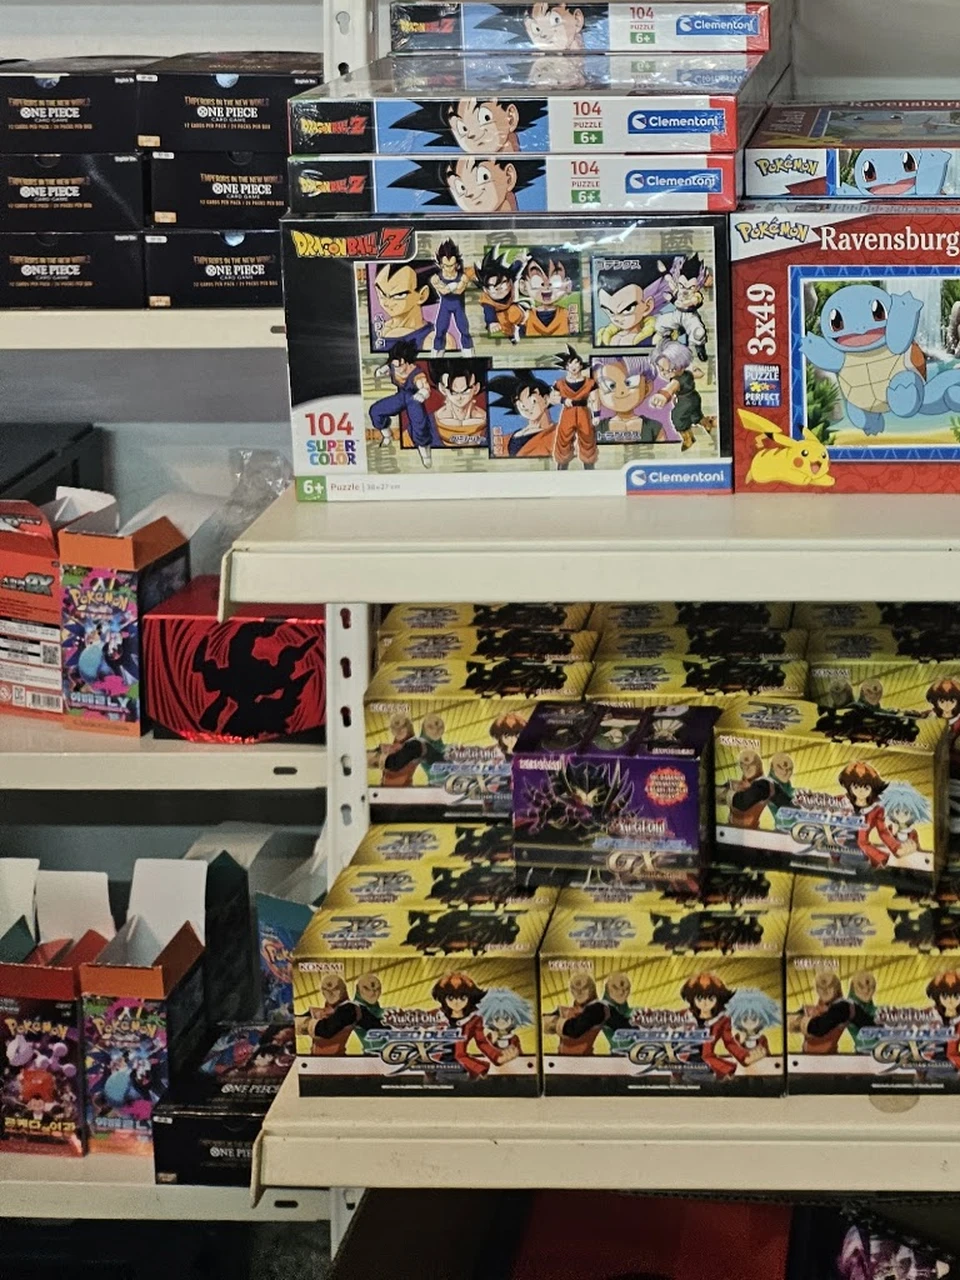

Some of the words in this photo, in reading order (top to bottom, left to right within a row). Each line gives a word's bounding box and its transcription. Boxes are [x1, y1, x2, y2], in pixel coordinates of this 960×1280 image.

[629, 6, 654, 19] 104
[694, 19, 755, 32] Clementoni
[635, 33, 651, 43] 6+
[20, 107, 47, 118] ONE
[48, 107, 80, 118] PIECE
[197, 106, 225, 117] ONE
[226, 106, 258, 117] PIECE
[573, 101, 602, 116] 104
[649, 114, 719, 128] Clementoni
[580, 132, 598, 143] 6+
[570, 160, 600, 176] 104
[646, 174, 717, 190] Clementoni
[20, 186, 47, 198] ONE
[48, 186, 80, 197] PIECE
[212, 183, 239, 195] ONE
[240, 183, 272, 195] PIECE
[578, 191, 595, 203] 6+
[291, 229, 348, 258] DRAGON
[347, 234, 381, 258] BALL
[379, 227, 412, 258] Z
[21, 264, 48, 276] ONE
[49, 265, 81, 276] PIECE
[205, 264, 232, 277] ONE
[233, 264, 265, 276] PIECE
[746, 283, 776, 356] 3x49
[744, 372, 780, 381] PUZZLE
[306, 412, 355, 437] 104
[306, 440, 356, 453] SUPER
[309, 452, 357, 466] COLOR
[649, 469, 725, 485] Clementoni
[303, 480, 325, 496] 6+
[330, 482, 361, 492] Puzzle
[299, 962, 344, 972] KONAMI
